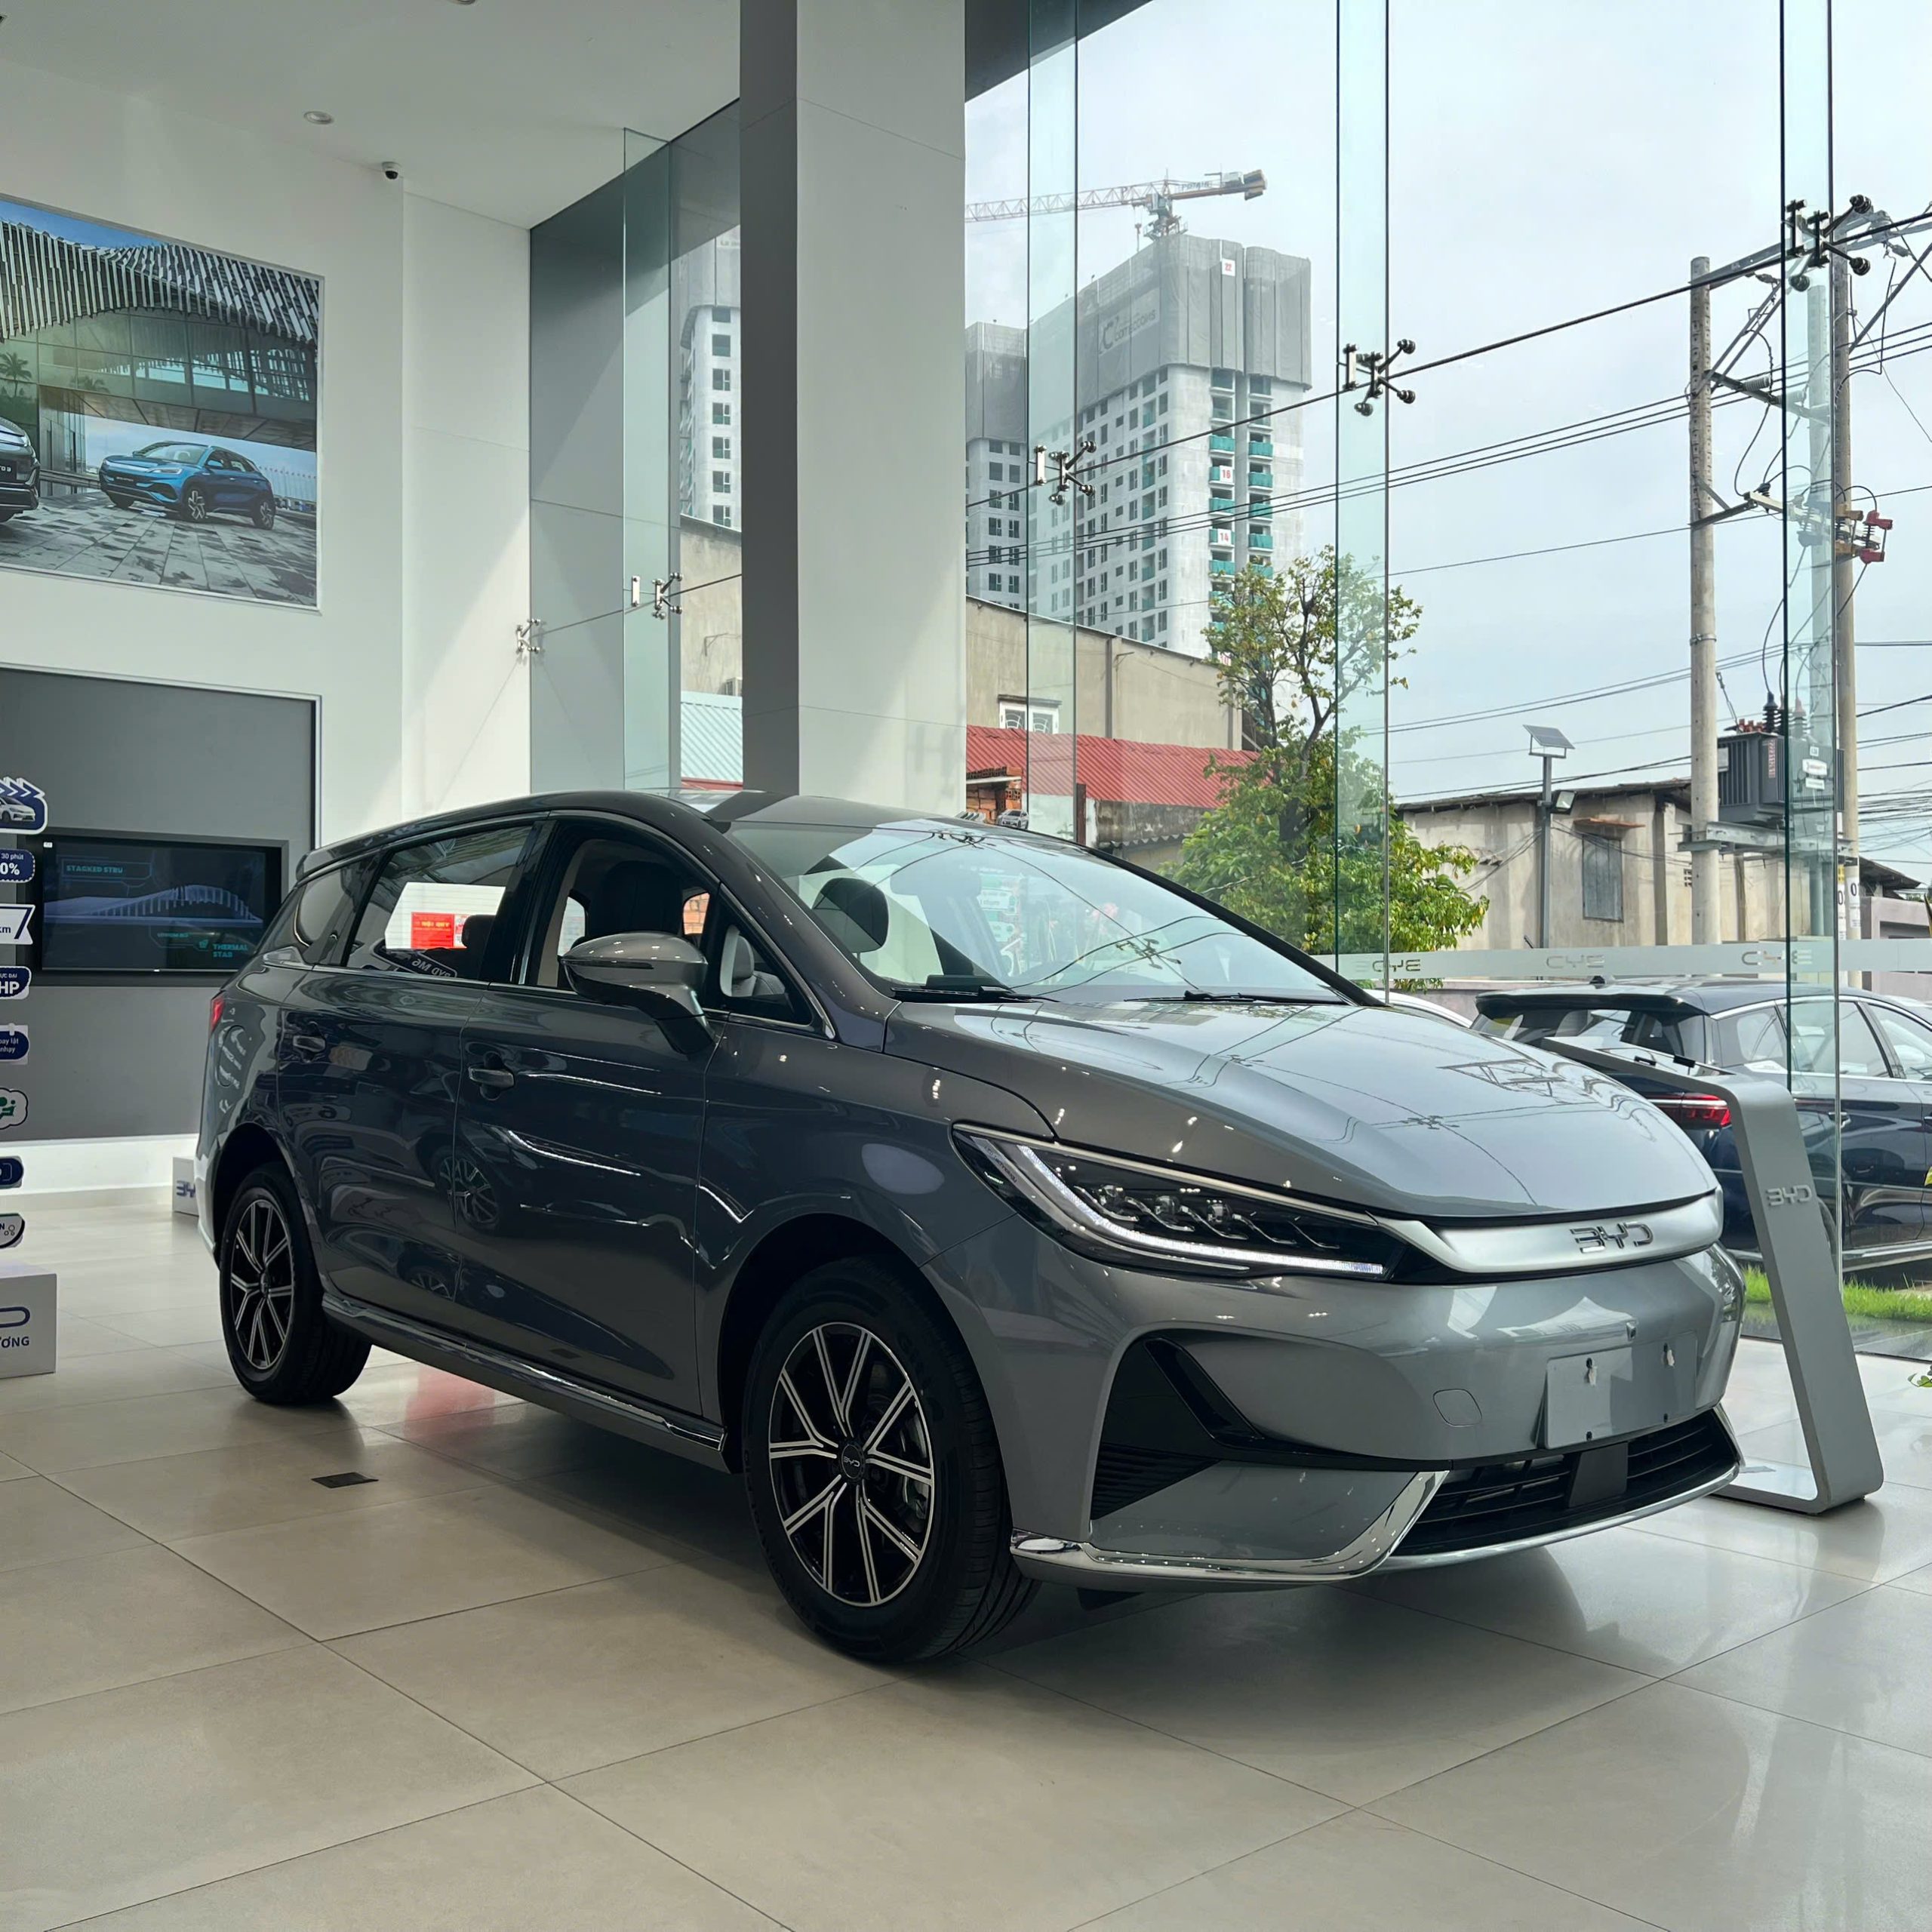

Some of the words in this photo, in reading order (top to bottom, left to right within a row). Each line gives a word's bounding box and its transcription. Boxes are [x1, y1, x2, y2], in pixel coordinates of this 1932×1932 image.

[1220, 532, 1229, 541] 14
[1766, 1184, 1813, 1207] BYD
[1570, 1221, 1654, 1254] BYD
[0, 1336, 29, 1349] ƠNG
